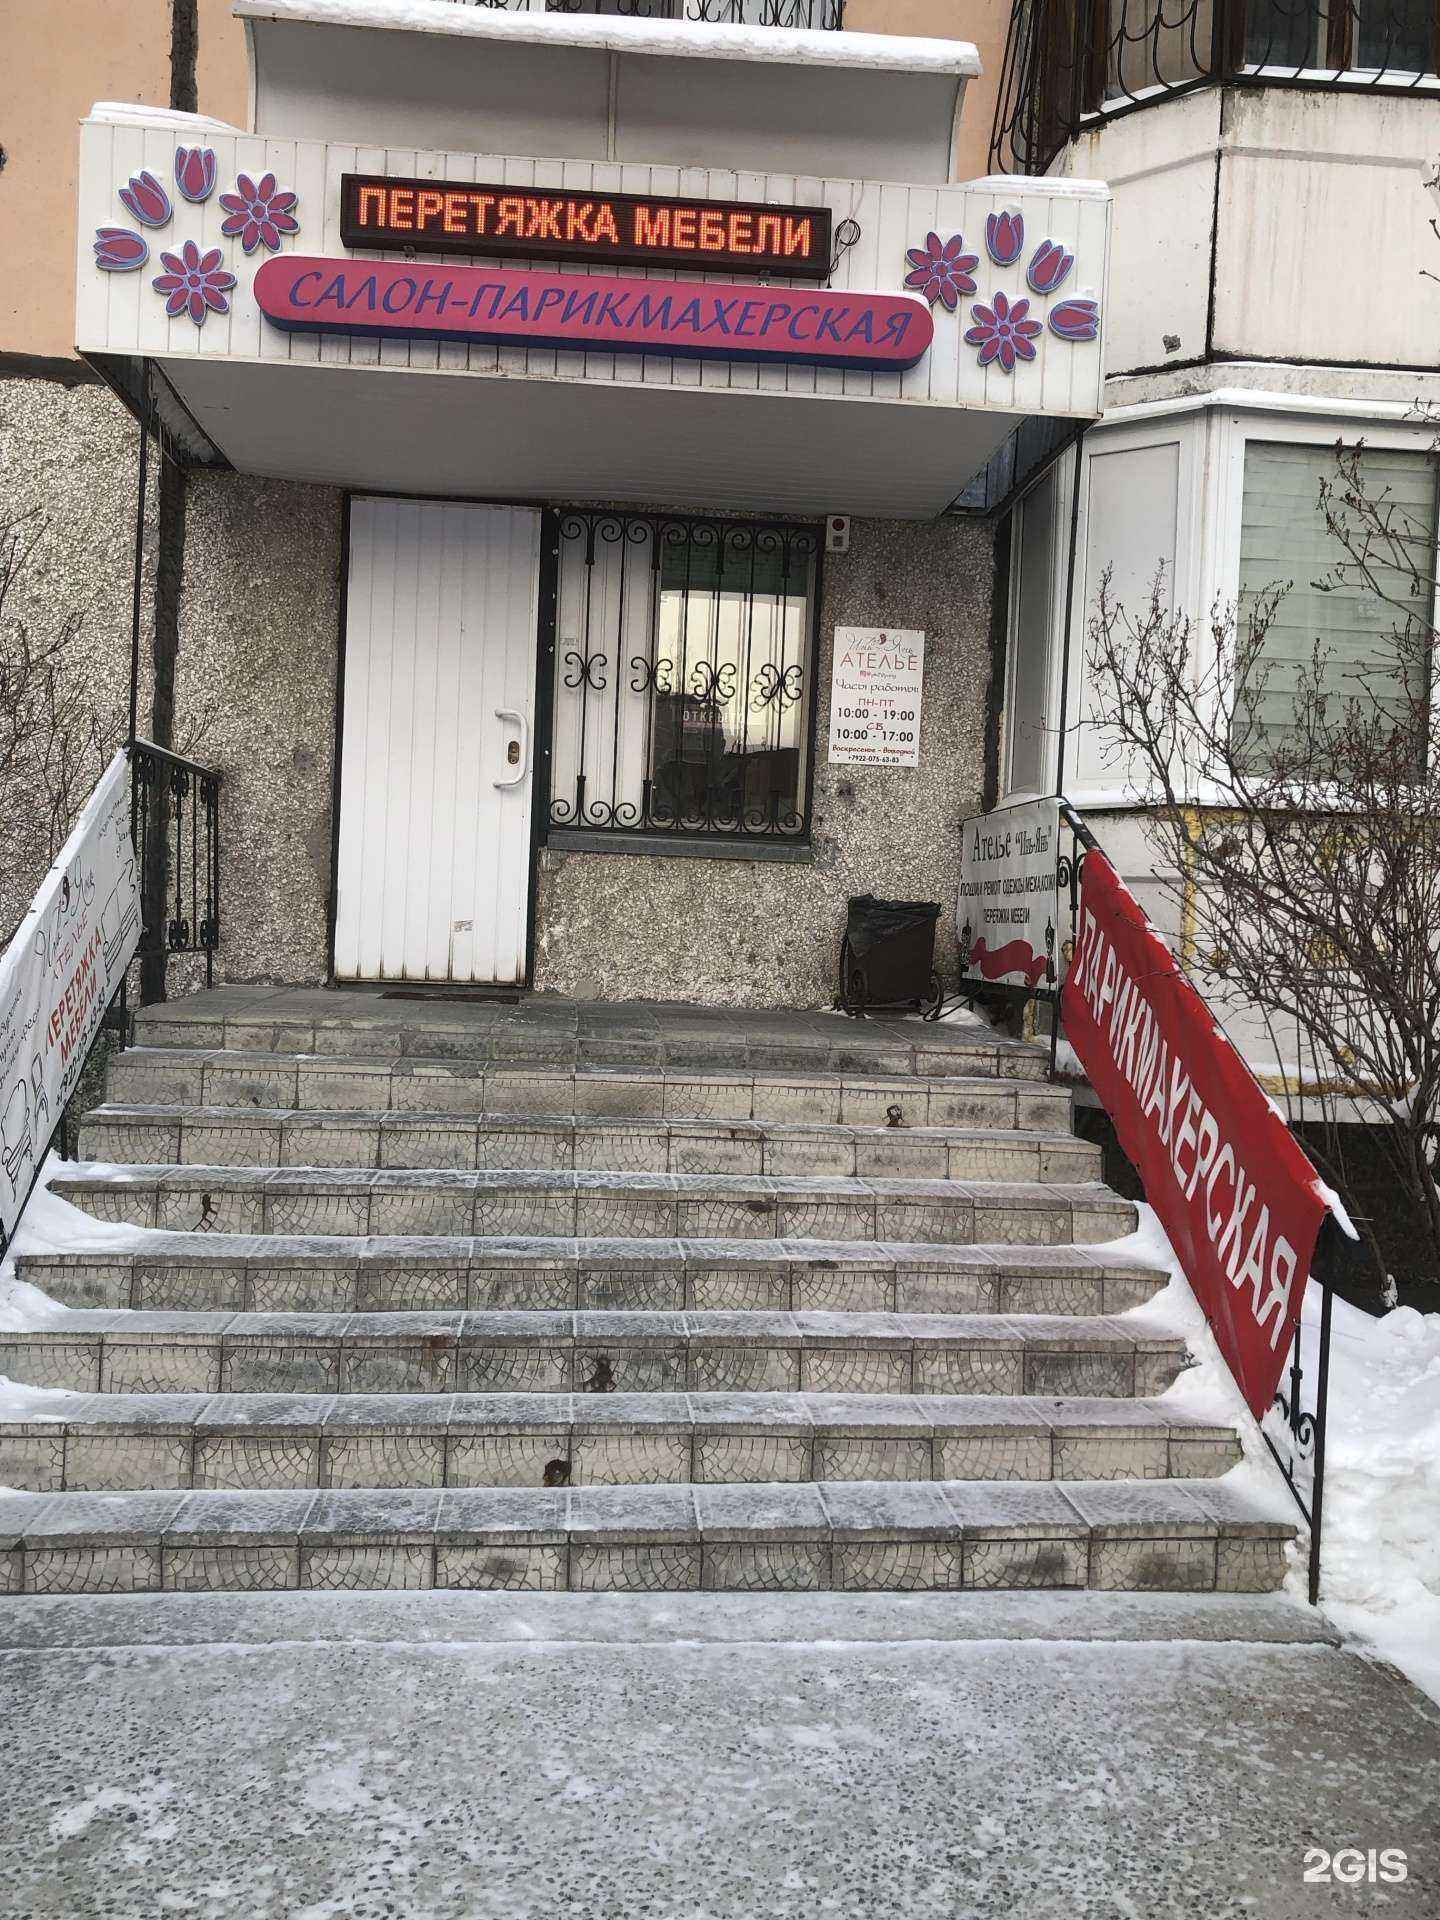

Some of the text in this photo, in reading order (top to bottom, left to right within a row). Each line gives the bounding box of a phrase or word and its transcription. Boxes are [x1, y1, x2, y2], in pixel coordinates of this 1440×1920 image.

[358, 184, 811, 258] ПЕРЕТЯЖКА МЕБЕЛИ
[288, 270, 913, 348] САЛОН-ПАРИКМАХЕРСКАЯ
[840, 652, 919, 671] АТЕЛЬЕ
[835, 678, 919, 694] Часы работы
[858, 698, 895, 707] ПН-ПТ
[838, 707, 869, 719] 10:00
[883, 710, 915, 721] 19:00
[836, 728, 868, 740] 10:00
[882, 731, 914, 742] 17:00
[972, 826, 1012, 863] Ателье
[1073, 905, 1299, 1352] ПАРИКМАХЕРСКАЯ
